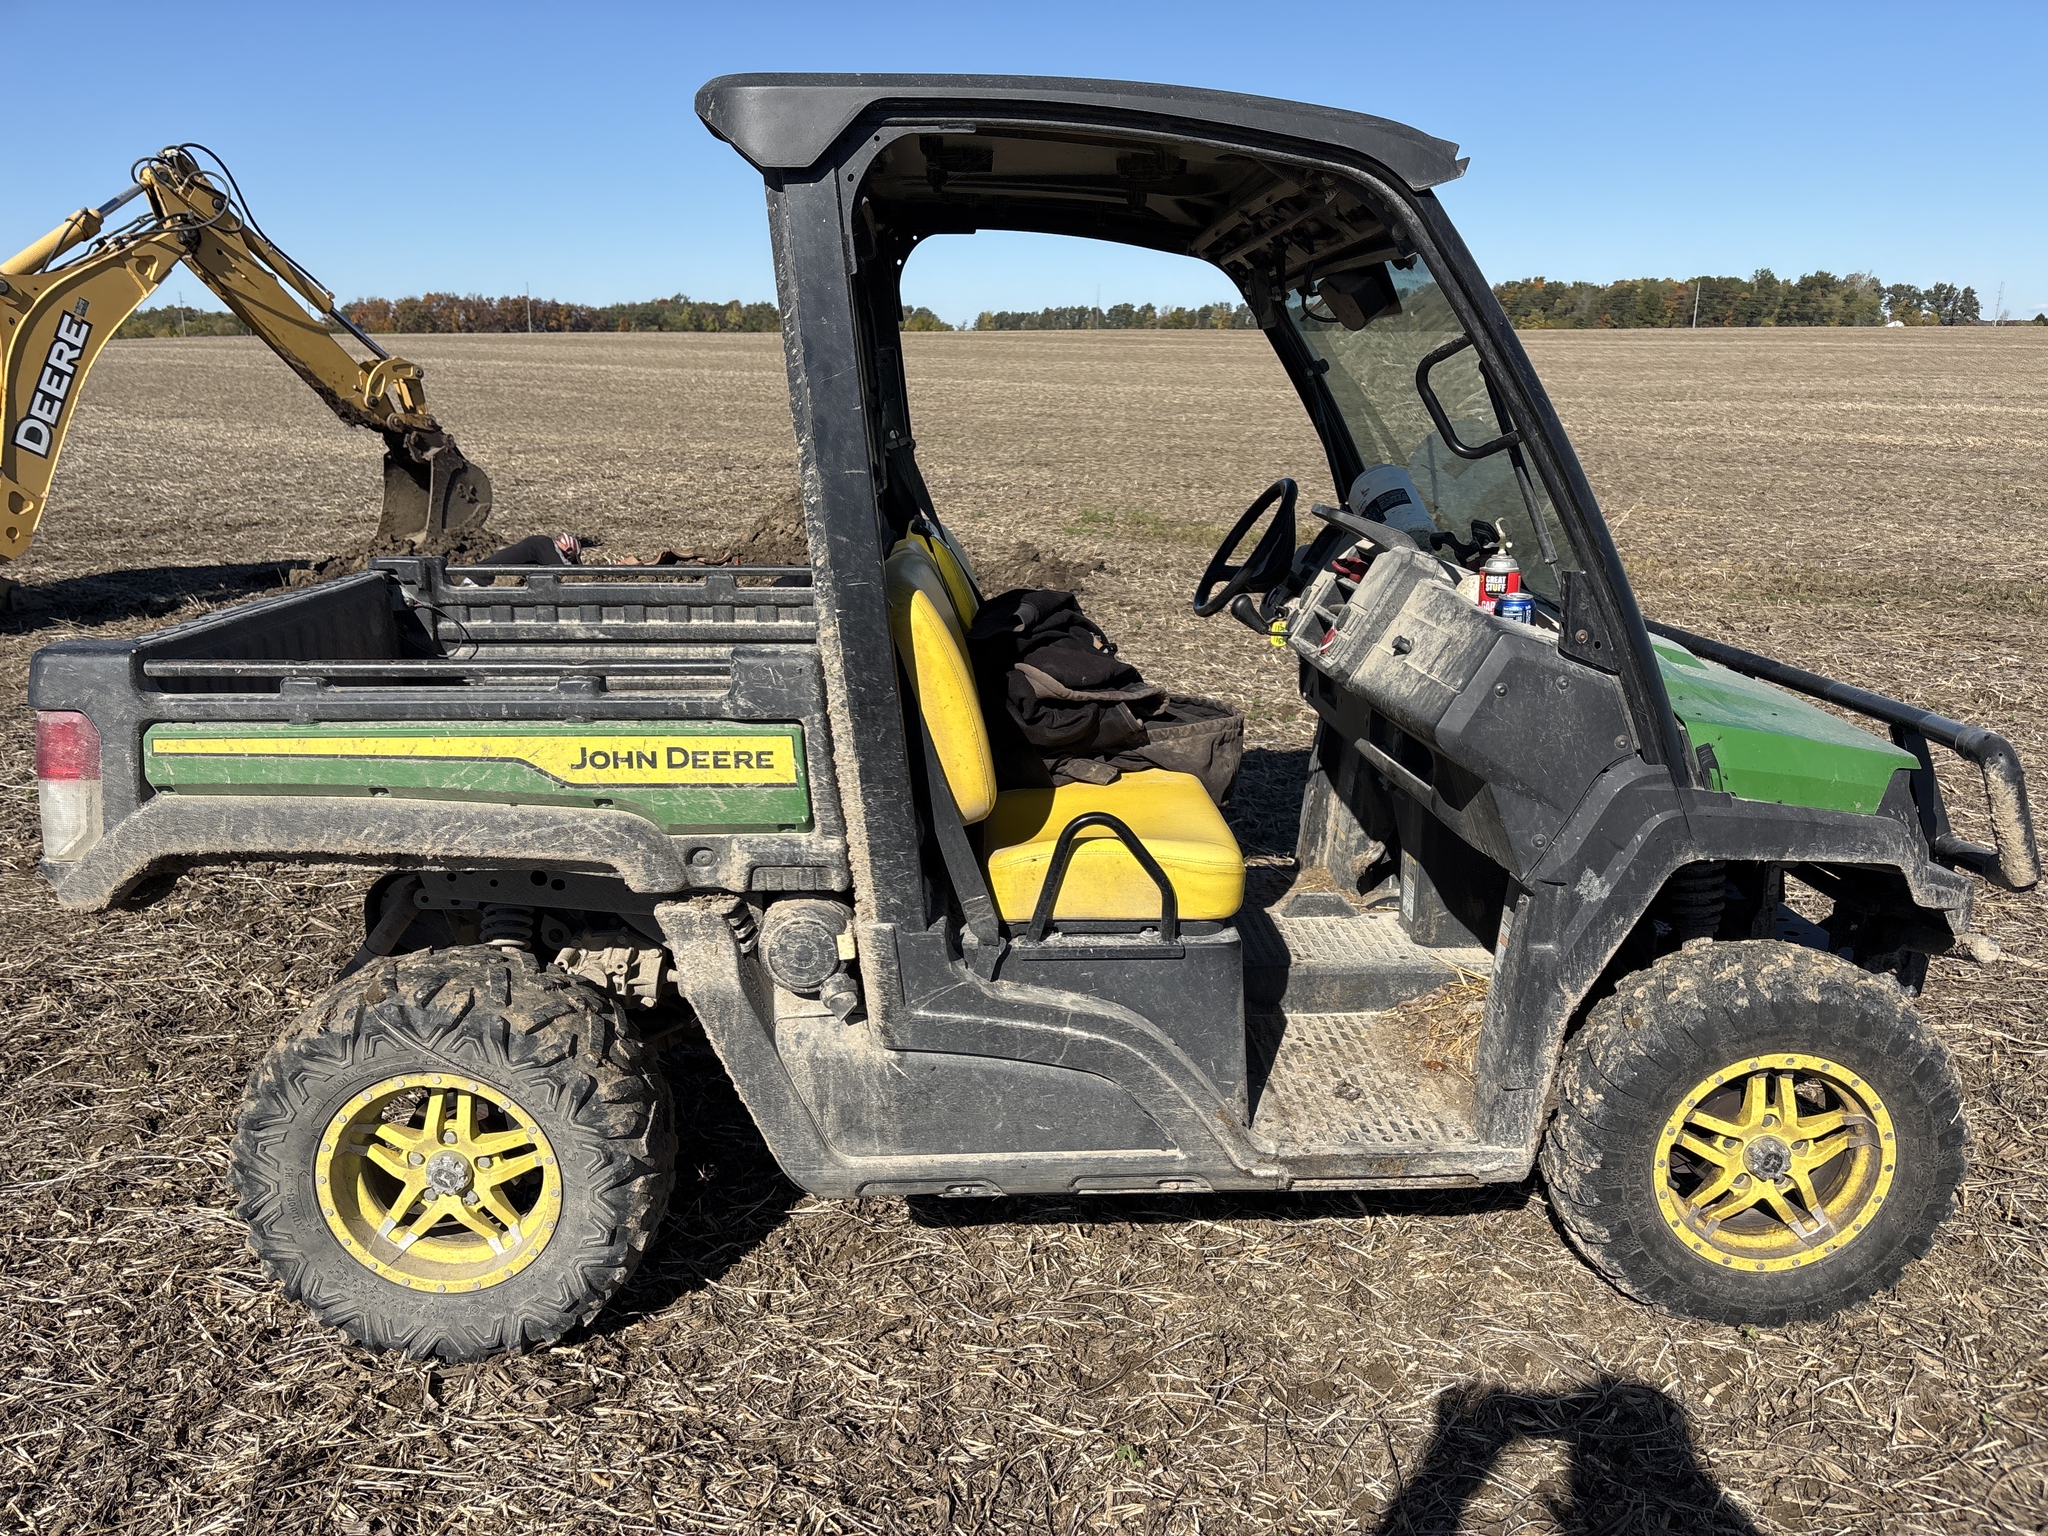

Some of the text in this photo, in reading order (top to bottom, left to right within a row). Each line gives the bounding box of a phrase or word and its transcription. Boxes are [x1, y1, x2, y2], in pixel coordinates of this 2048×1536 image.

[15, 313, 89, 456] DEERE
[1485, 575, 1507, 584] GREAT
[1485, 584, 1507, 592] STUFF
[1481, 600, 1496, 612] GAP
[570, 746, 775, 770] JOHN DEERE
